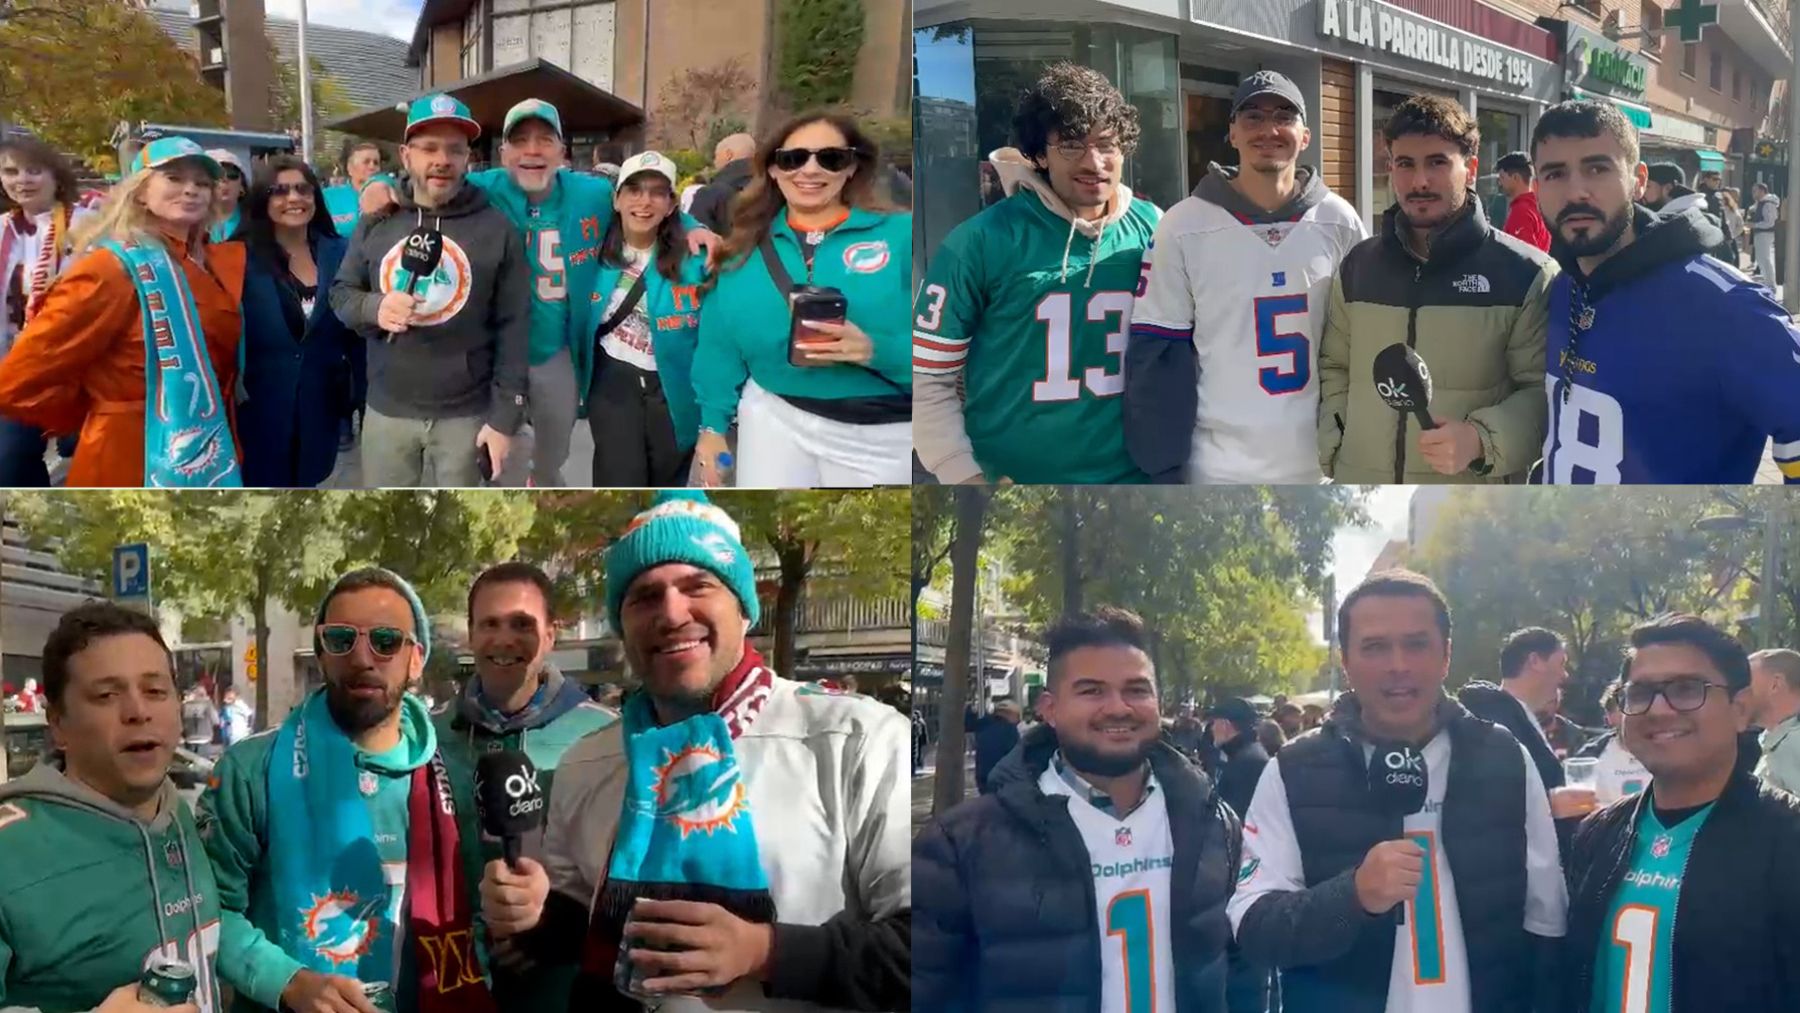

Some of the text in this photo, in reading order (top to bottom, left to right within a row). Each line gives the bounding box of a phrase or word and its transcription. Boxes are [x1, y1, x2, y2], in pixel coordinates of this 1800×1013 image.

[1323, 0, 1533, 88] A LA PARRILLA DESDE 1954
[410, 233, 436, 252] ok
[1032, 290, 1138, 402] 13
[1253, 293, 1311, 395] 5
[1377, 377, 1409, 398] ok
[120, 551, 140, 592] P
[505, 764, 541, 798] ok
[1385, 747, 1421, 772] ok
[1106, 888, 1158, 1013] 1
[1612, 903, 1661, 1013] 1
